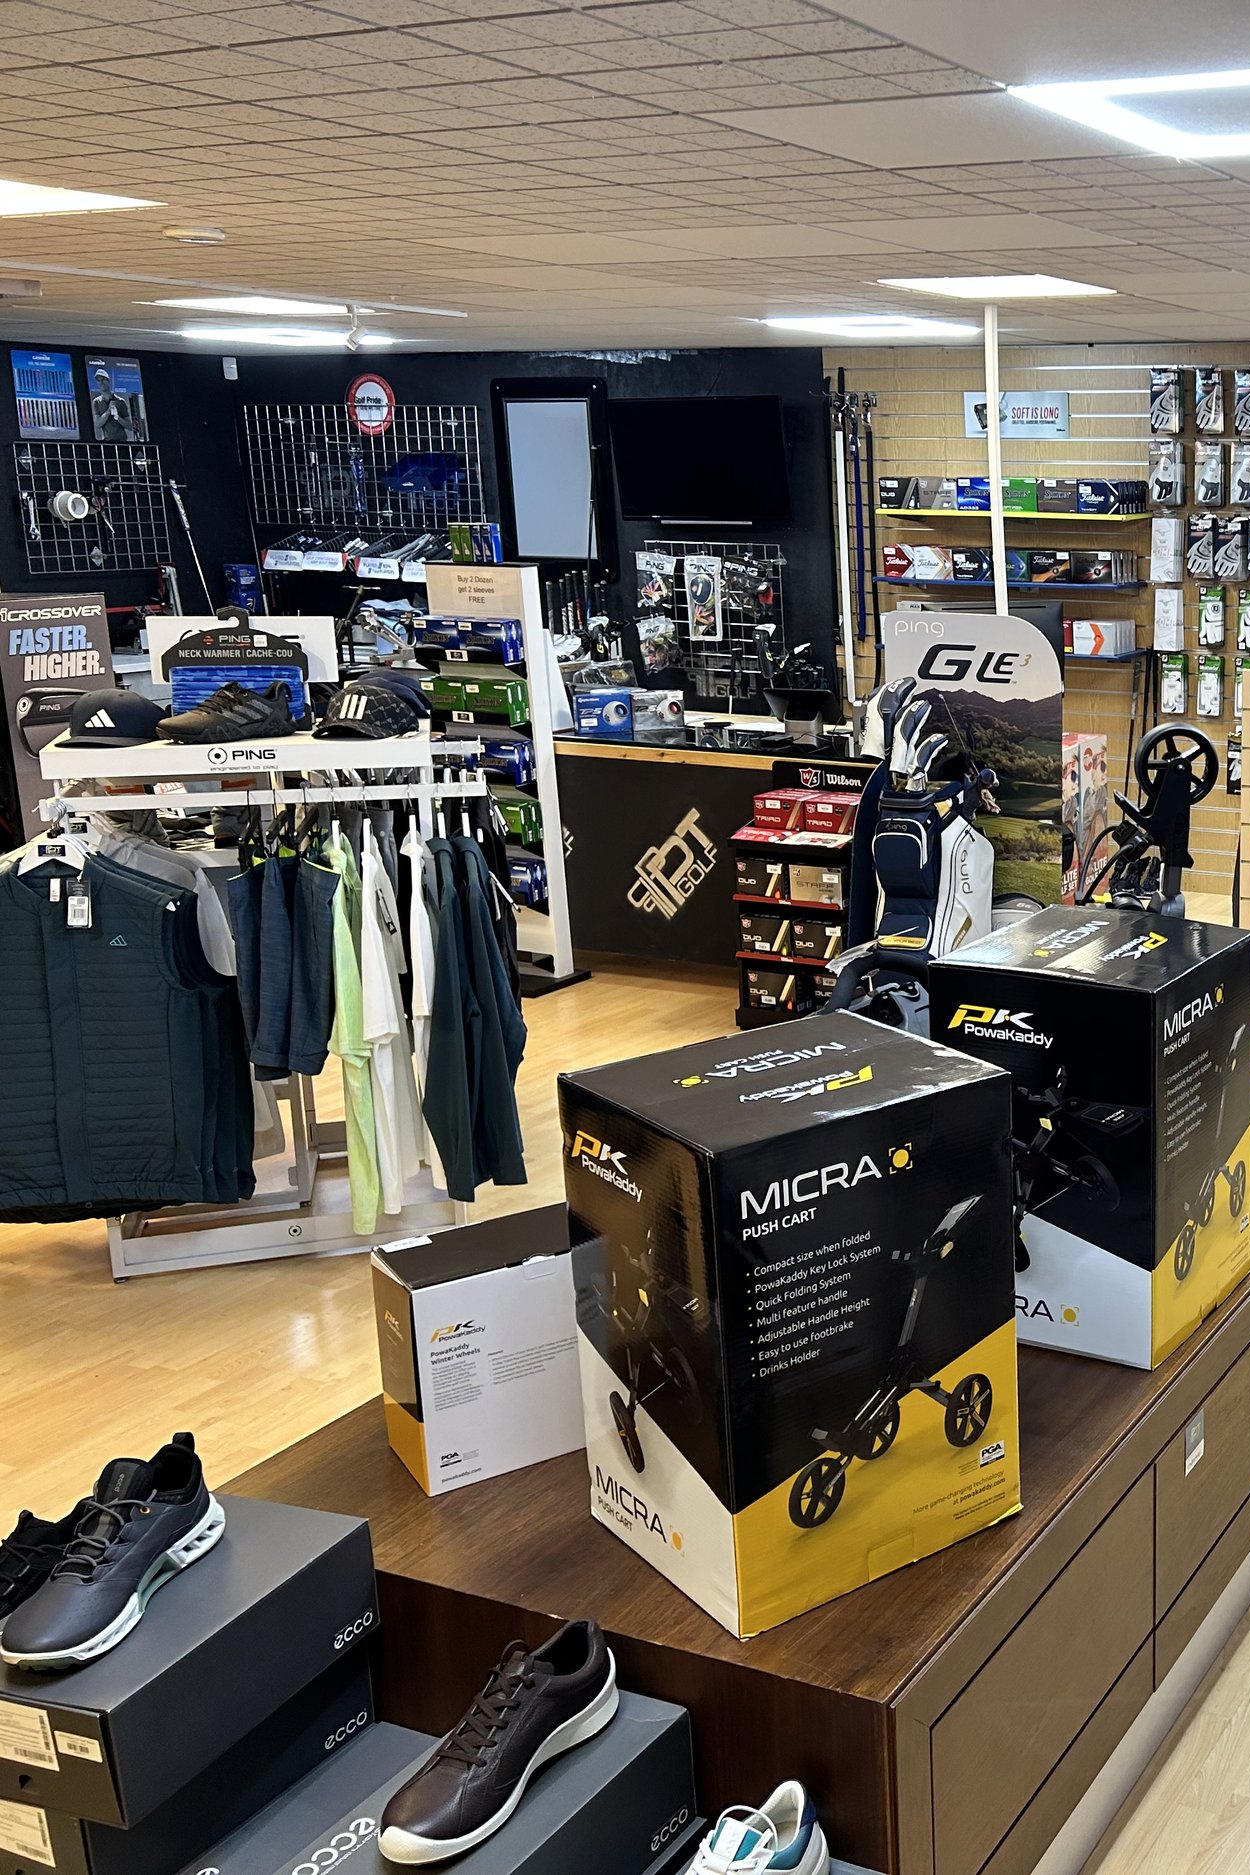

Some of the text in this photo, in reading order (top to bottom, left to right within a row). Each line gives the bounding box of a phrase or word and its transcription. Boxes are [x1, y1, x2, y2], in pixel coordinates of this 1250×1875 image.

[354, 396, 381, 404] Golf Pride
[1011, 406, 1059, 419] SOFT IS LONG
[1080, 493, 1105, 502] Titleist
[645, 561, 665, 570] PING
[729, 565, 758, 577] PING
[886, 557, 908, 565] Titleist
[955, 560, 979, 569] Titleist
[457, 575, 468, 585] Buy
[475, 576, 493, 584] Dozen
[458, 586, 466, 594] get
[473, 586, 495, 594] sleeves
[9, 624, 93, 656] FASTER.
[218, 635, 250, 643] PING
[894, 619, 944, 638] ping
[178, 649, 293, 658] NECK WARMER CACHE-COU
[23, 650, 106, 682] HIGHER.
[39, 703, 61, 712] PING
[232, 749, 276, 760] PING
[826, 773, 862, 787] Wilson
[755, 815, 781, 823] TRIAD
[806, 819, 833, 827] TRIAD
[676, 847, 719, 898] GOLF
[738, 877, 756, 885] DUO
[960, 849, 974, 894] ping
[742, 933, 762, 941] DUO
[795, 940, 814, 948] DUO
[749, 987, 768, 995] DUO
[947, 1004, 1034, 1030] PK
[1163, 992, 1214, 1041] MICRA
[964, 1022, 1054, 1049] PowaKaddy
[1163, 1032, 1191, 1057] PUSH CART
[705, 1041, 848, 1079] MICRA
[714, 1050, 784, 1069] PUSH CART
[738, 1070, 855, 1104] PowaKaddy
[571, 1130, 629, 1176] PK
[581, 1154, 643, 1203] PowaKaddy
[740, 1154, 883, 1220] MICRA
[742, 1207, 817, 1241] PUSH CART
[754, 1230, 871, 1277] Compact size when folded
[754, 1244, 881, 1294] PowaKaddy Key Lock System
[755, 1271, 851, 1313] Quick Folding System
[756, 1288, 848, 1327] Multi feature handle
[757, 1297, 871, 1345] Adjustable Handle Height
[438, 1325, 487, 1343] PowaKaddy
[758, 1318, 854, 1363] Easy to use footbrake
[430, 1342, 470, 1358] PowaKaddy
[431, 1347, 481, 1366] Winter Wheels
[759, 1347, 822, 1378] Drinks Holder
[441, 1452, 460, 1461] PGA
[981, 1443, 1002, 1458] PGA
[113, 1472, 125, 1494] ecco
[442, 1467, 482, 1484] powakaddy.com
[913, 1502, 929, 1515] More
[929, 1484, 973, 1509] game-changing
[973, 1470, 1005, 1489] technology
[953, 1498, 959, 1506] at
[959, 1477, 1006, 1504] powakaddy.com
[595, 1464, 668, 1544] MICRA
[597, 1494, 634, 1534] PUSH CART
[332, 1609, 374, 1651] ecco
[324, 1709, 369, 1751] ecco
[650, 1807, 689, 1852] ecco
[291, 1817, 377, 1875] ecco
